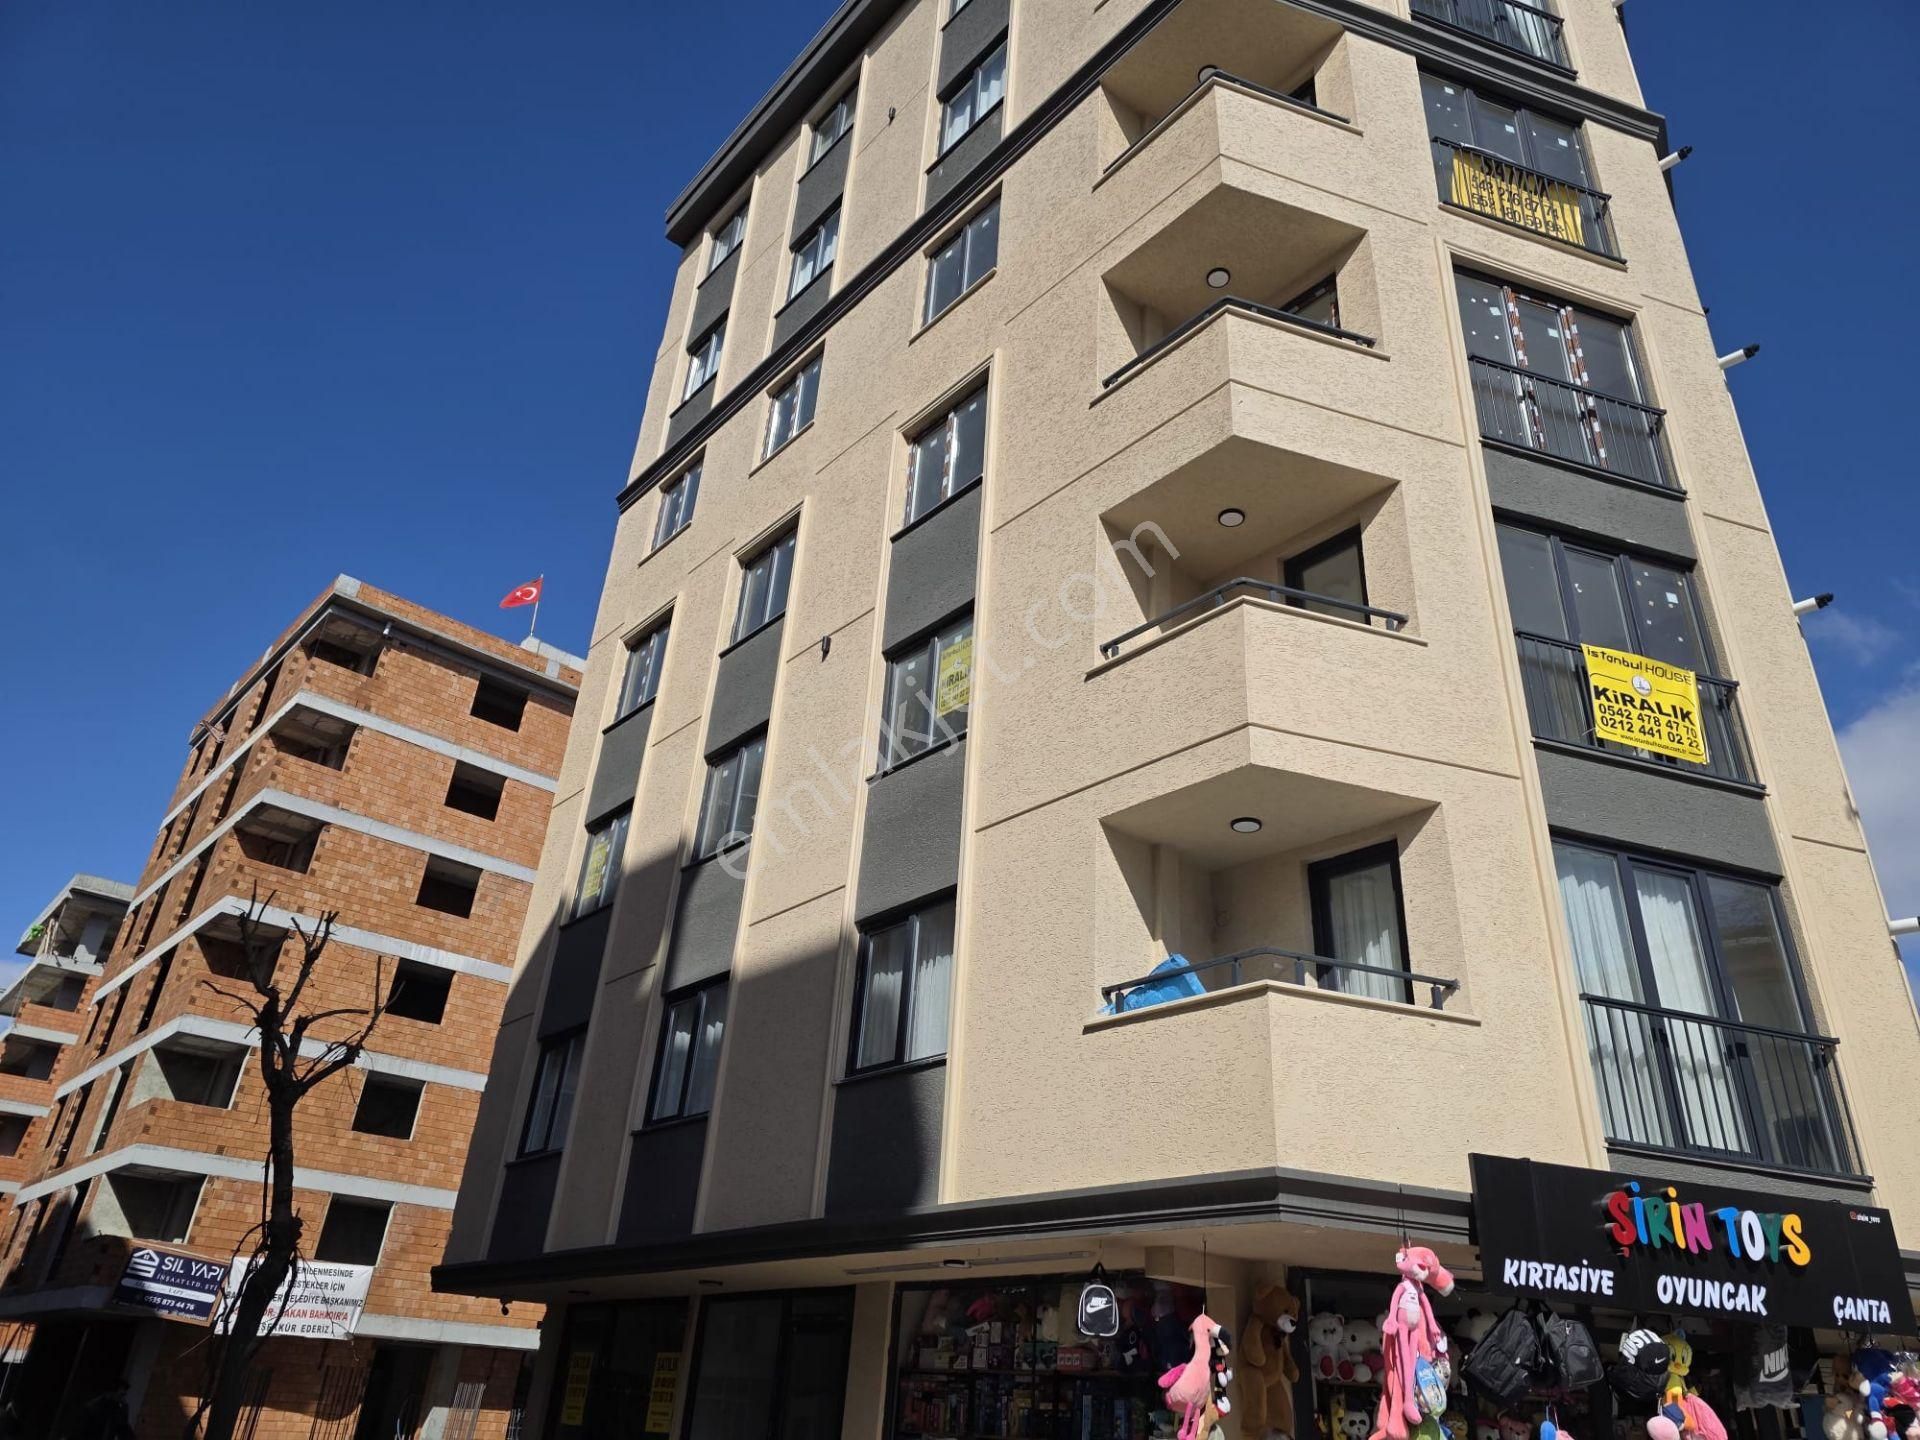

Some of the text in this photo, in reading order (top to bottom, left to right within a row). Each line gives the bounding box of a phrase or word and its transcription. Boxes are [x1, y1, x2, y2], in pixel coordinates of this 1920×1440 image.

[1645, 664, 1692, 685] HOUSE
[1599, 704, 1697, 738] 0542 478 47 70
[1600, 715, 1701, 750] 0212 441 02 22
[1604, 1180, 1811, 1267] ŞİRİN TOYS
[192, 1260, 224, 1281] YAPI
[330, 1280, 346, 1292] İÇİN
[1503, 1258, 1614, 1296] KIRTASİYE
[1657, 1274, 1768, 1316] OYUNCAK
[1833, 1295, 1892, 1327] ÇANTA
[284, 1309, 308, 1319] AKAN
